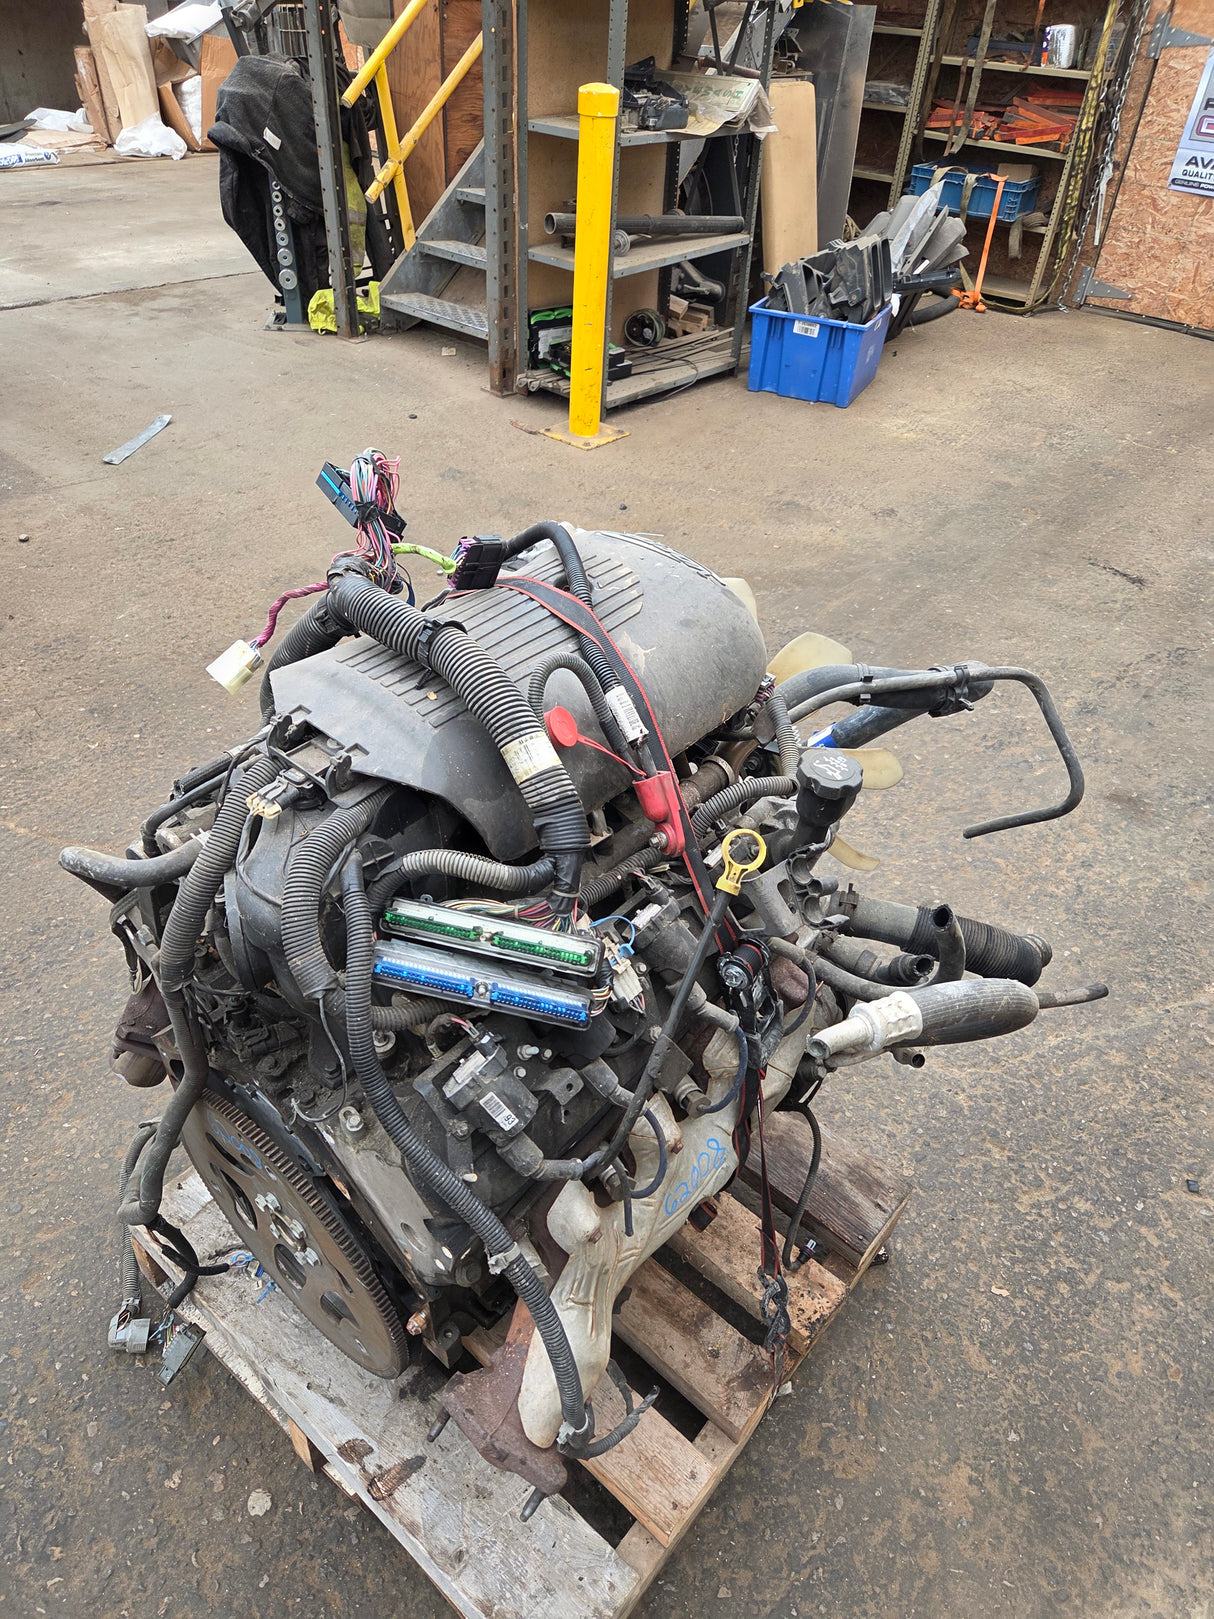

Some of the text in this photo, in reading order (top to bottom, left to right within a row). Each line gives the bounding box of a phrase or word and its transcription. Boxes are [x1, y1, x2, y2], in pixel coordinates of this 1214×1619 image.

[1181, 169, 1214, 180] QUALIT
[504, 1113, 517, 1125] 93
[664, 1137, 727, 1216] 62008
